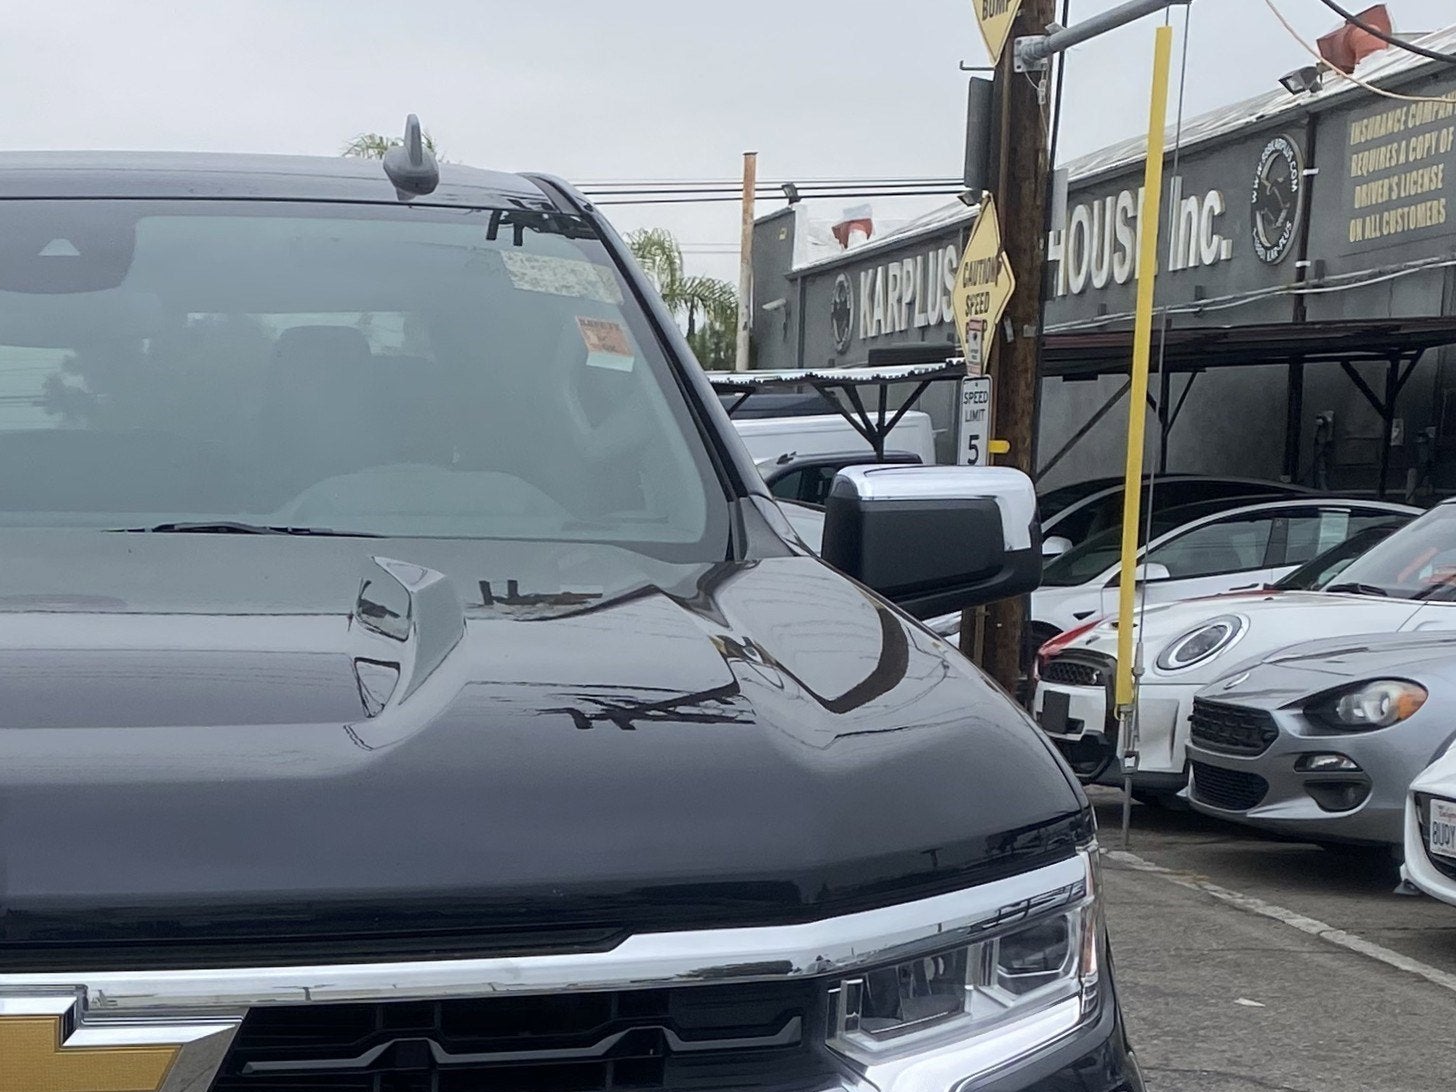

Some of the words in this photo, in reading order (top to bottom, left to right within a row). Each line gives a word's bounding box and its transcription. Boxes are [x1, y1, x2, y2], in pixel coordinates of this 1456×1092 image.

[1351, 107, 1407, 145] INSURANCE
[1408, 91, 1456, 128] COMPAN
[1351, 142, 1398, 177] REQUIRES
[1398, 140, 1406, 165] A
[1409, 131, 1438, 162] COPY
[1439, 126, 1454, 153] OF
[1354, 175, 1398, 208] DRIVER'S
[1400, 163, 1444, 198] LICENSE
[1350, 218, 1362, 242] ON
[1365, 214, 1380, 239] ALL
[1382, 198, 1446, 236] CUSTOMERS
[859, 245, 957, 340] KARPLUS
[1168, 176, 1233, 271] Inc.
[963, 256, 998, 288] CAUTION
[965, 291, 990, 317] SPEED
[963, 390, 988, 405] SPEED
[965, 409, 985, 423] LIMIT
[967, 434, 980, 466] 5
